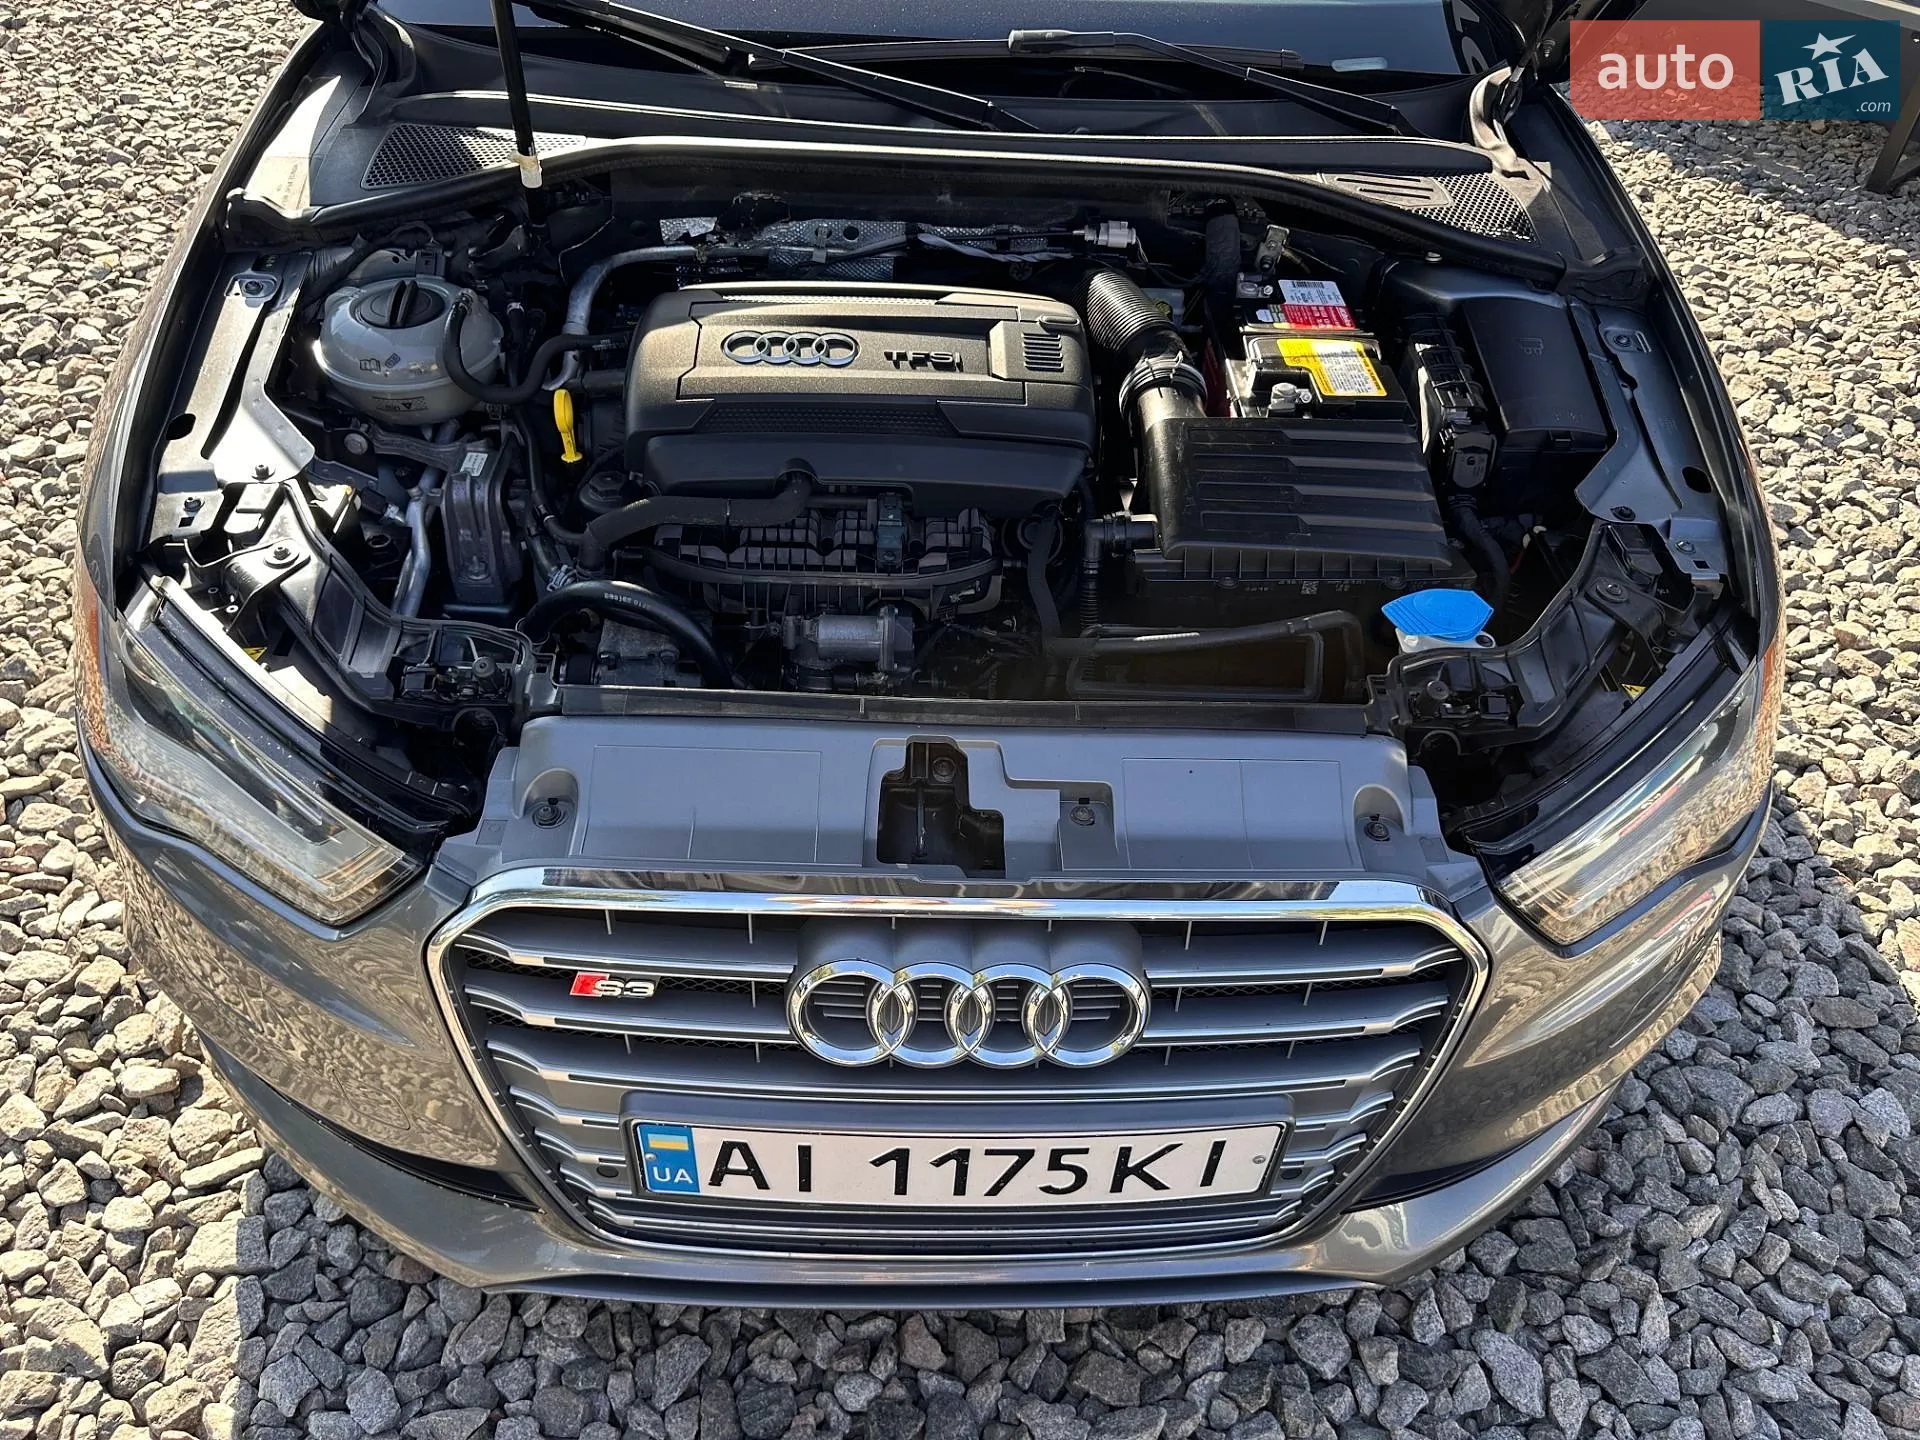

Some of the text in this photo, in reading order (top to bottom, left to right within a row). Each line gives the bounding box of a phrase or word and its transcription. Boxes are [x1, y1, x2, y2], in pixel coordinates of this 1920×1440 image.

[883, 350, 964, 372] TFSI
[592, 979, 655, 998] S3
[653, 1166, 694, 1185] UA
[708, 1139, 812, 1193] AI
